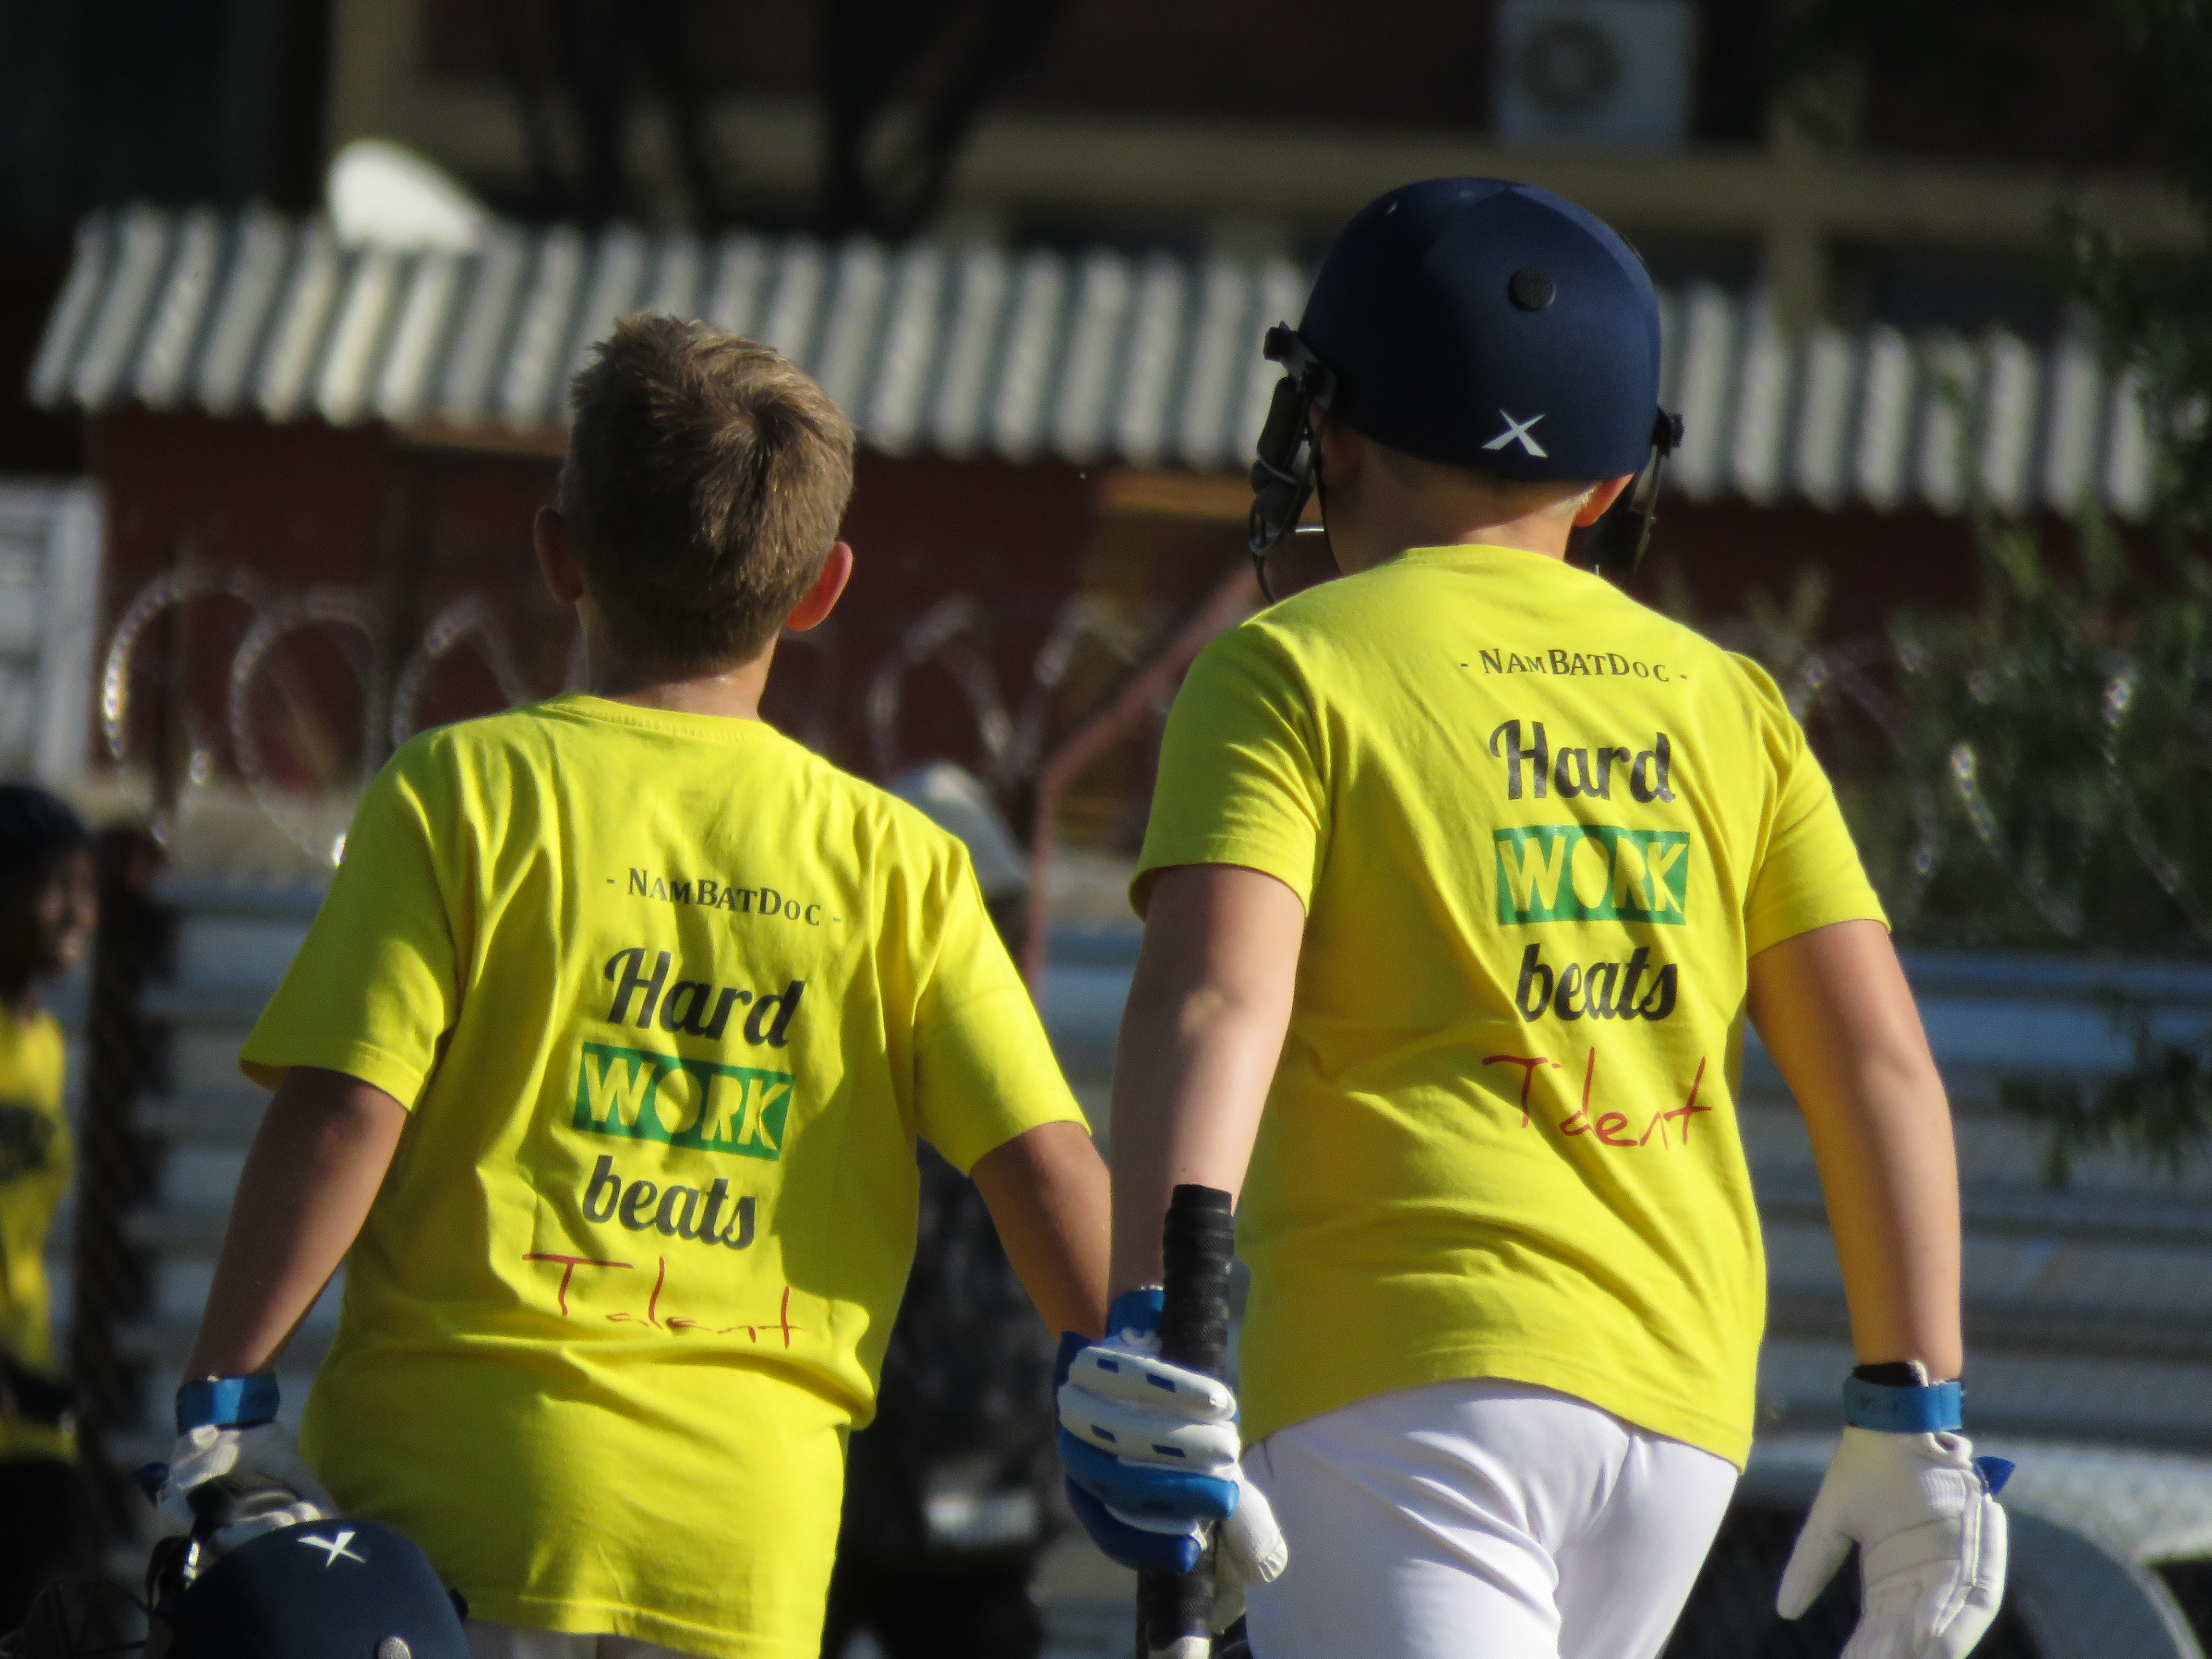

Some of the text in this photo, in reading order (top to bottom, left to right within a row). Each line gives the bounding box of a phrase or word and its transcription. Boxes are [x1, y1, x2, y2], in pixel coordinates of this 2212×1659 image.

[1489, 719, 1676, 803] Hard
[1498, 836, 1687, 913] WORK
[604, 947, 805, 1048] Hard
[1515, 943, 1678, 1022] beats
[584, 1053, 790, 1151] WORK
[582, 1154, 756, 1250] beats
